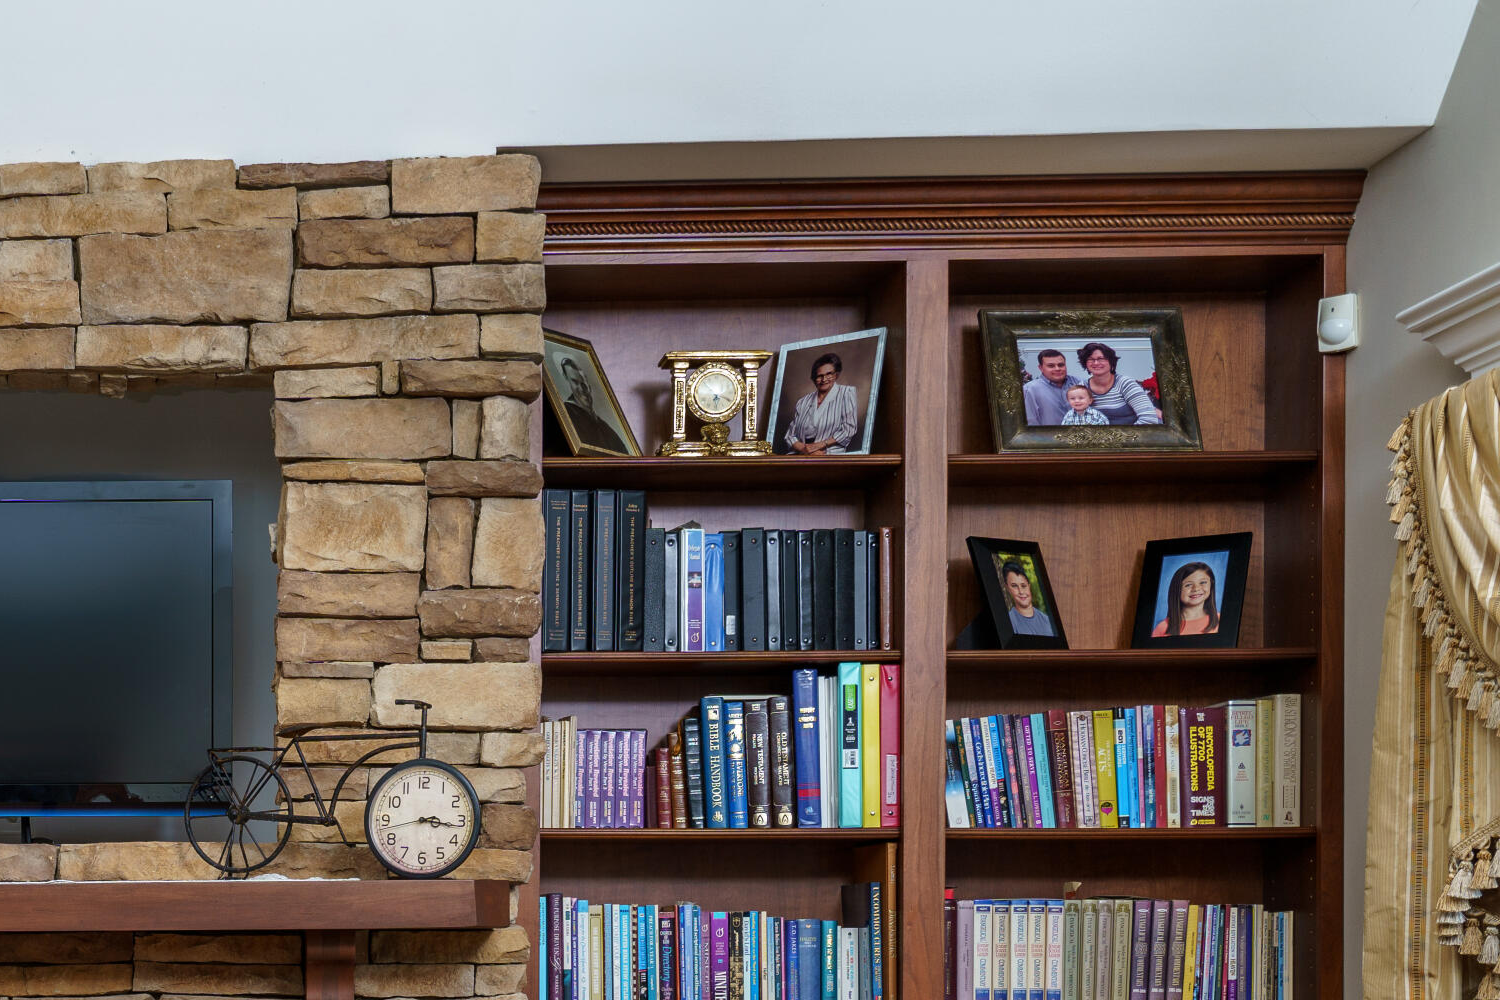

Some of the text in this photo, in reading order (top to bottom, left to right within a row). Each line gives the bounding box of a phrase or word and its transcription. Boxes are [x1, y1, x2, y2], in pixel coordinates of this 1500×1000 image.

[1198, 726, 1205, 739] OF
[1054, 732, 1064, 790] COMMENTARY
[1059, 732, 1070, 788] EVANGELICAL
[1097, 747, 1107, 773] ACTS
[1189, 726, 1198, 792] ILLUSTRATIONS
[1205, 725, 1214, 791] ENCYCLOPEDIA
[708, 723, 722, 808] BIBLE HANDBOOK
[757, 749, 765, 785] TESTAMENT
[782, 747, 790, 786] TESTAMENT
[418, 776, 431, 790] 12
[736, 761, 744, 797] EVERYONE
[402, 782, 410, 794] 11
[441, 782, 446, 794] 1
[388, 796, 402, 808] 10
[451, 796, 460, 808] 2
[381, 815, 390, 827] 9
[457, 815, 466, 828] 3
[387, 833, 396, 845] 8
[449, 834, 458, 846] 4
[401, 847, 409, 859] 7
[418, 852, 426, 865] 6
[436, 847, 445, 860] 5
[872, 886, 881, 964] UNCOMMON CURES
[661, 946, 673, 982] Directory
